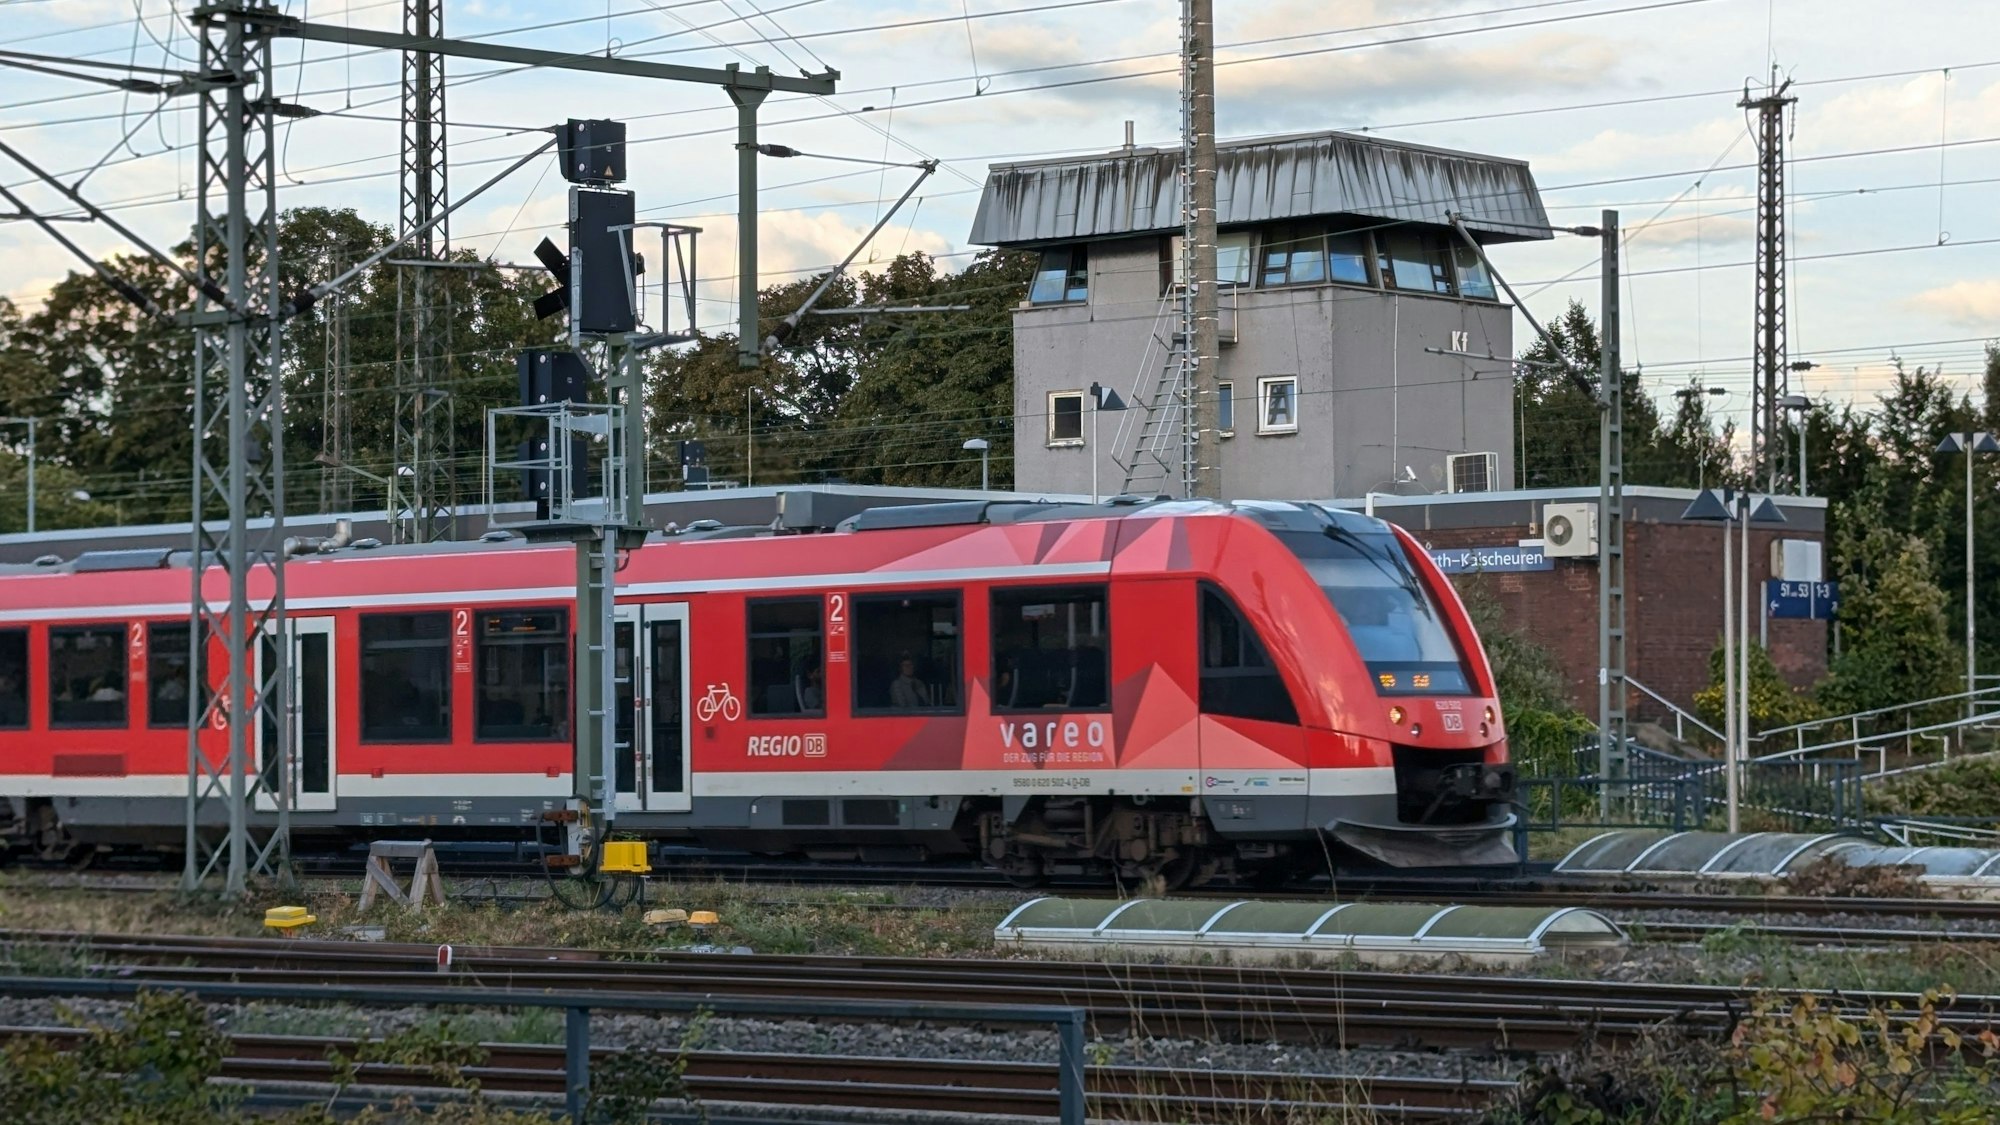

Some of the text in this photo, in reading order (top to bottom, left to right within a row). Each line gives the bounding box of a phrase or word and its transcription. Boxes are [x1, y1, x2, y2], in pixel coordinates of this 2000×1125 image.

[1452, 331, 1468, 352] Kf
[1780, 583, 1790, 597] 51
[1798, 584, 1808, 598] 53
[1816, 584, 1830, 598] 1-3
[830, 595, 843, 621] 2
[456, 611, 468, 635] 2
[131, 623, 143, 647] 2
[1443, 714, 1462, 730] DB
[1000, 721, 1104, 748] vareo
[747, 735, 825, 756] REGIO DB
[1003, 752, 1019, 762] DER
[1056, 752, 1070, 762] DIE
[1072, 752, 1103, 762] REGION
